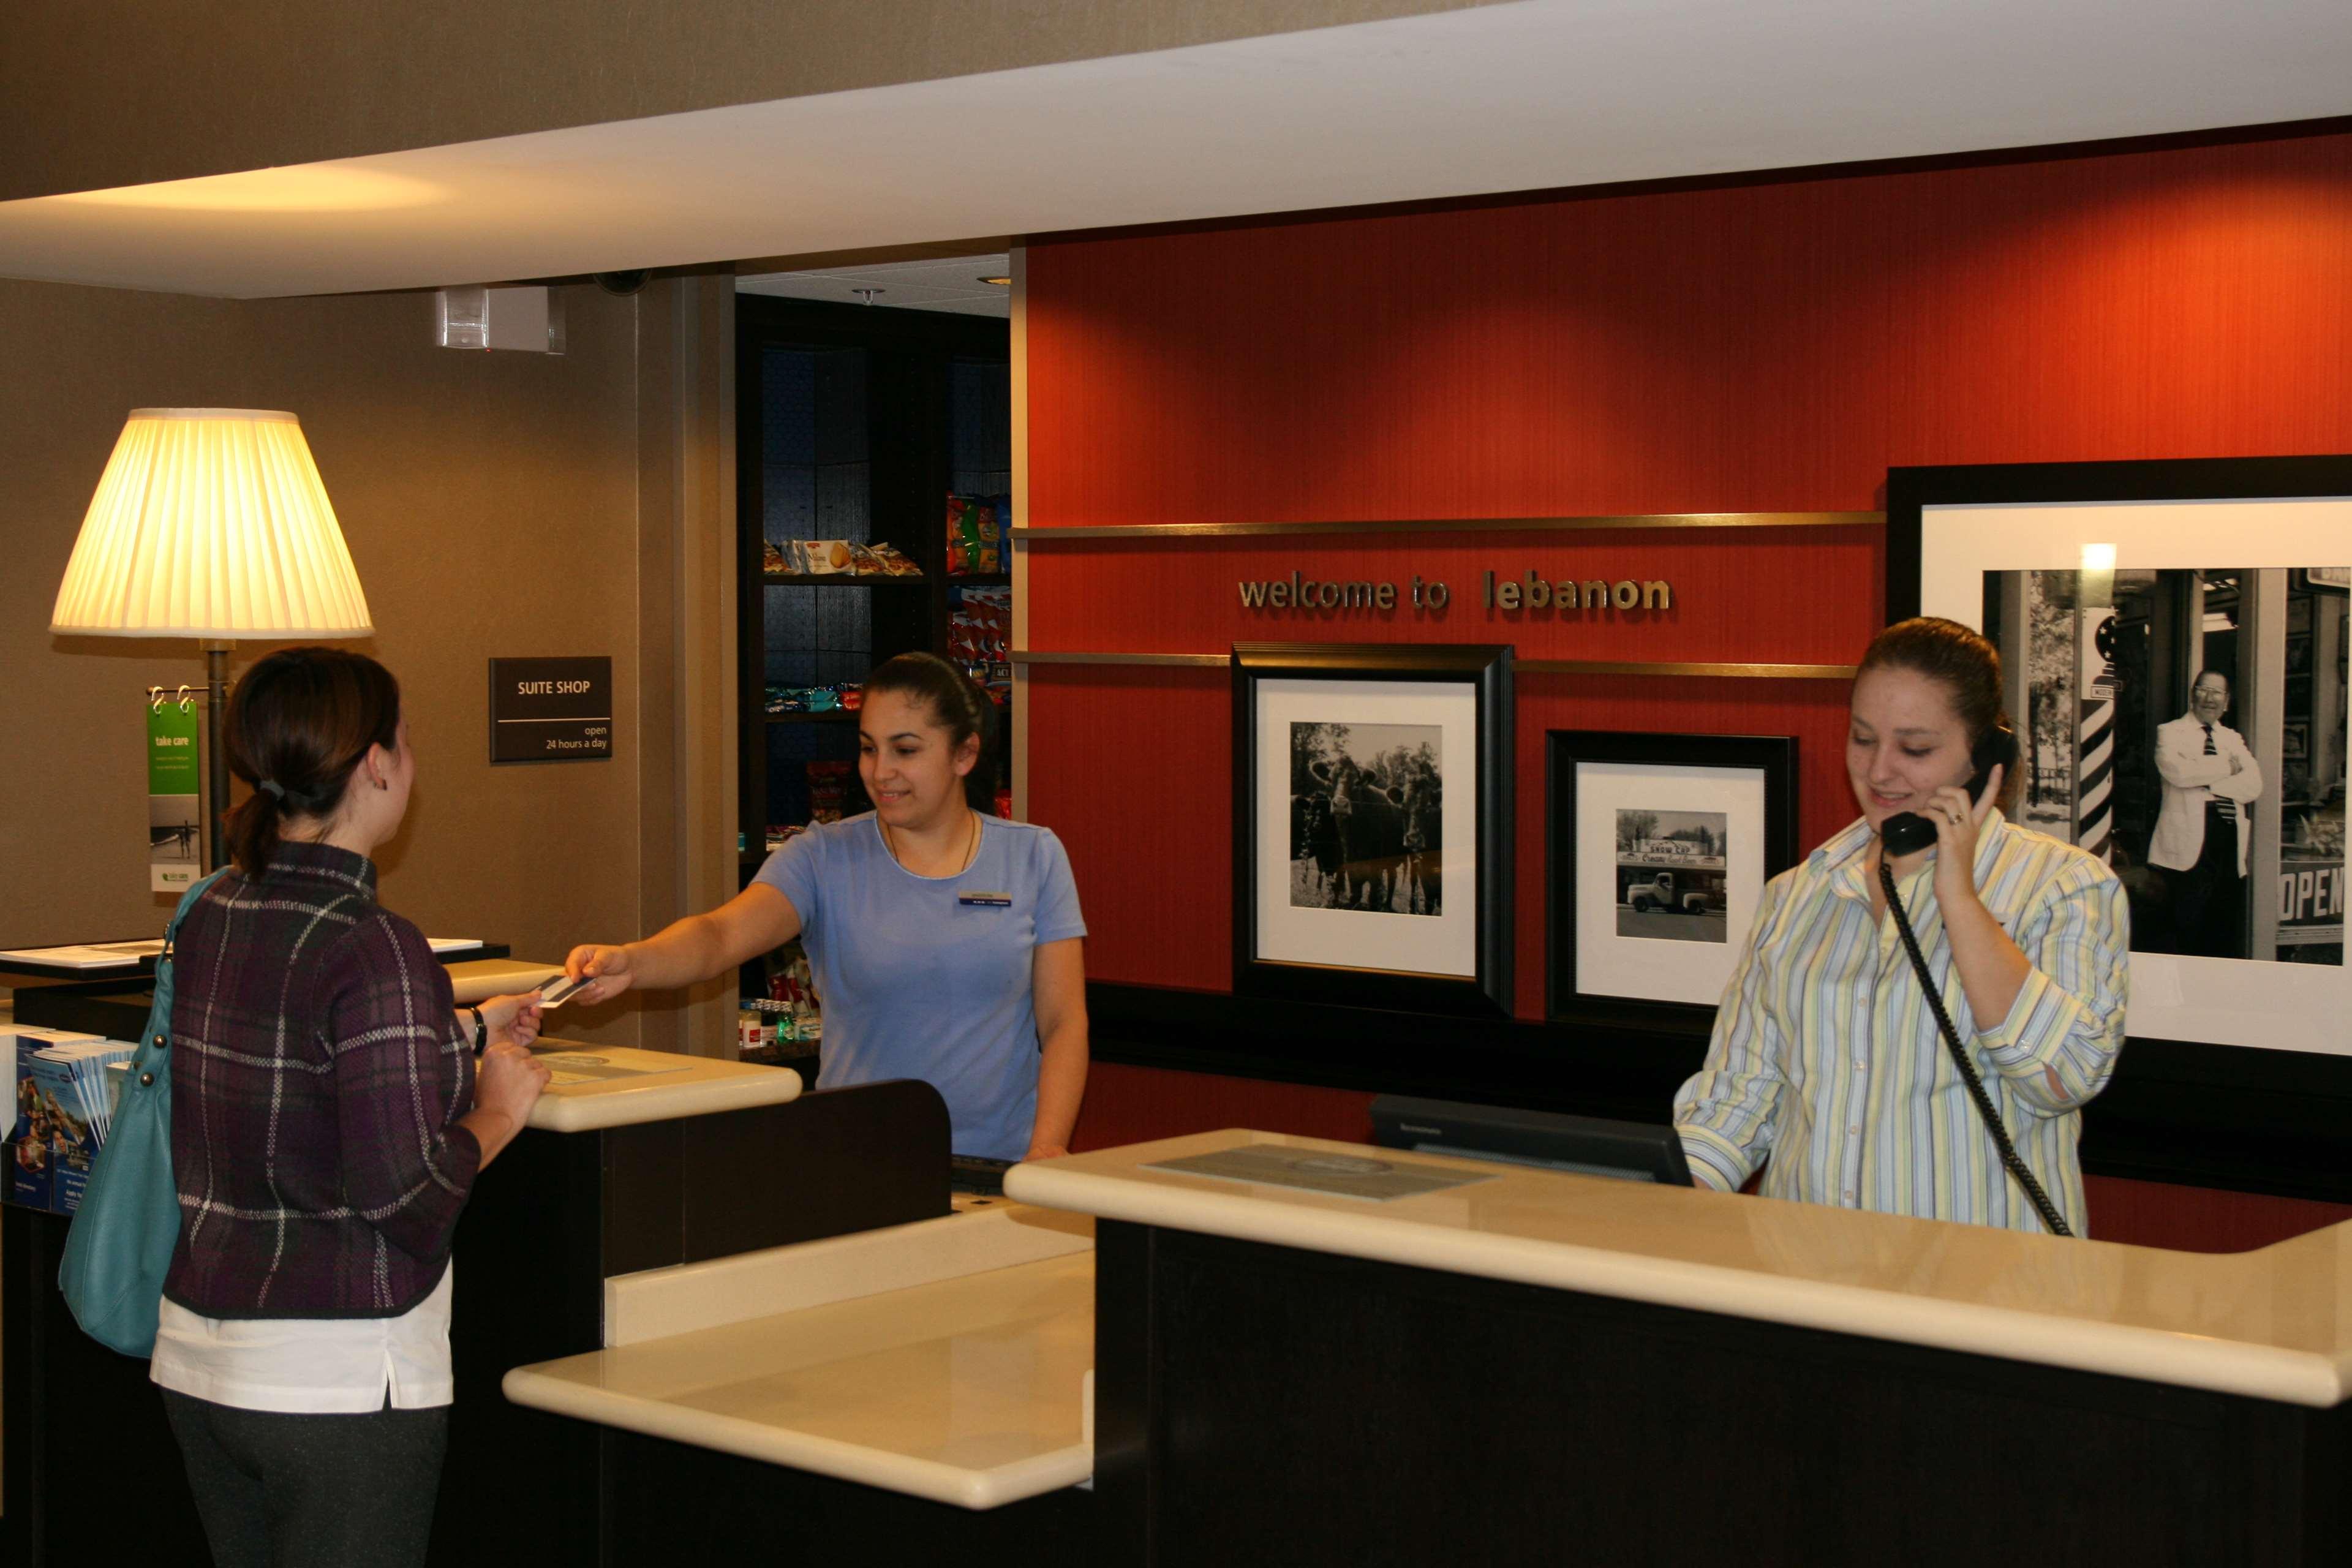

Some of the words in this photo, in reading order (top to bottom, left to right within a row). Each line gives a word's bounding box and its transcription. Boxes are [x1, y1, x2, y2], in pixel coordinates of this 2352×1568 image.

[1238, 571, 1395, 609] welcome
[1411, 575, 1447, 608] to
[1483, 570, 1670, 609] lebanon
[518, 681, 552, 695] SUITE
[556, 680, 590, 694] SHOP
[584, 727, 606, 737] open
[155, 736, 172, 746] take
[173, 737, 189, 746] care
[546, 739, 556, 749] 24
[558, 739, 582, 748] hours
[591, 738, 606, 749] day
[2278, 867, 2344, 921] OPEN
